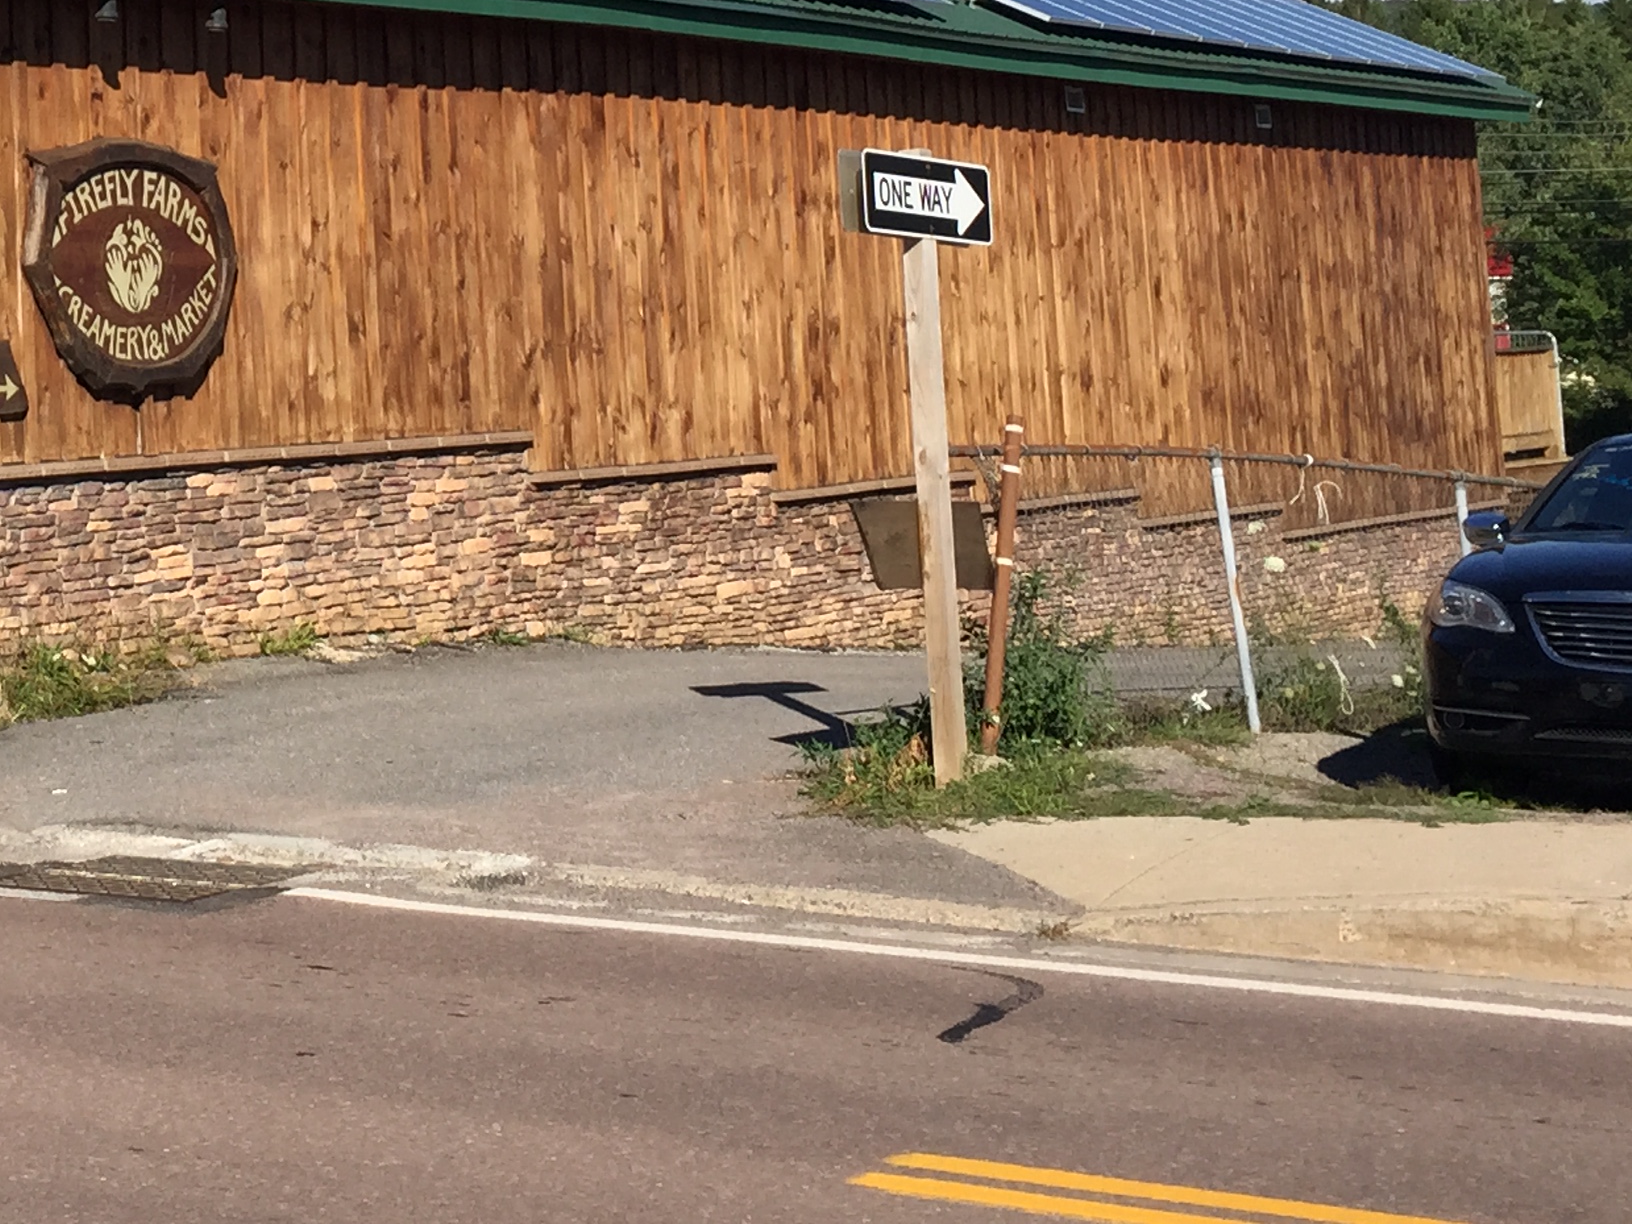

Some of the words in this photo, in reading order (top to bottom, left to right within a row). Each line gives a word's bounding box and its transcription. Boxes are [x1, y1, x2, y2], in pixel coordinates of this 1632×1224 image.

[141, 170, 208, 245] FARMS
[879, 177, 914, 209] ONE
[919, 182, 953, 214] WAY
